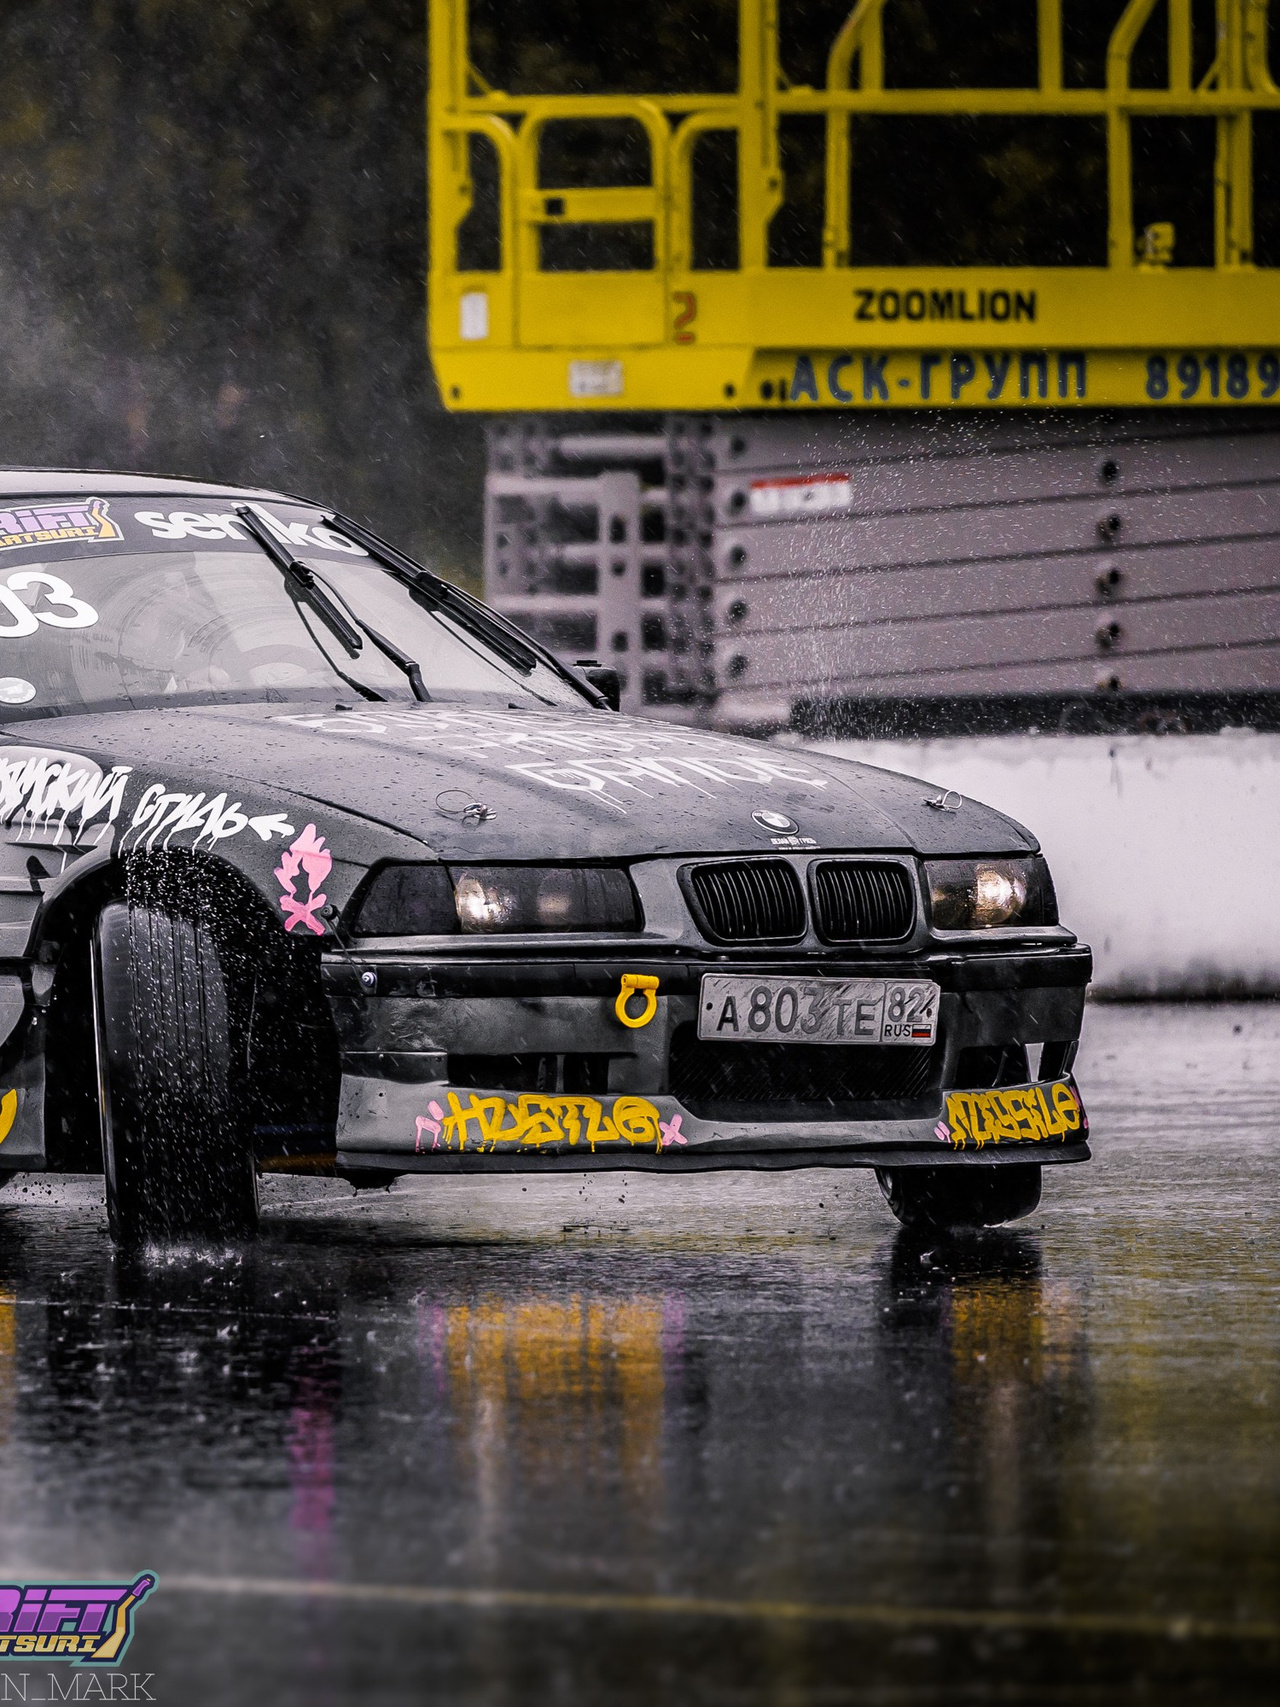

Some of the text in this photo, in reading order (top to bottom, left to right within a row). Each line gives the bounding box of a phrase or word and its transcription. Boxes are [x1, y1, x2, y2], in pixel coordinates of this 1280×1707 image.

[853, 289, 1038, 322] ZOOMLION
[789, 353, 1087, 402] АСК-ГРУПП
[887, 986, 926, 1023] 82
[883, 1024, 911, 1038] RUS
